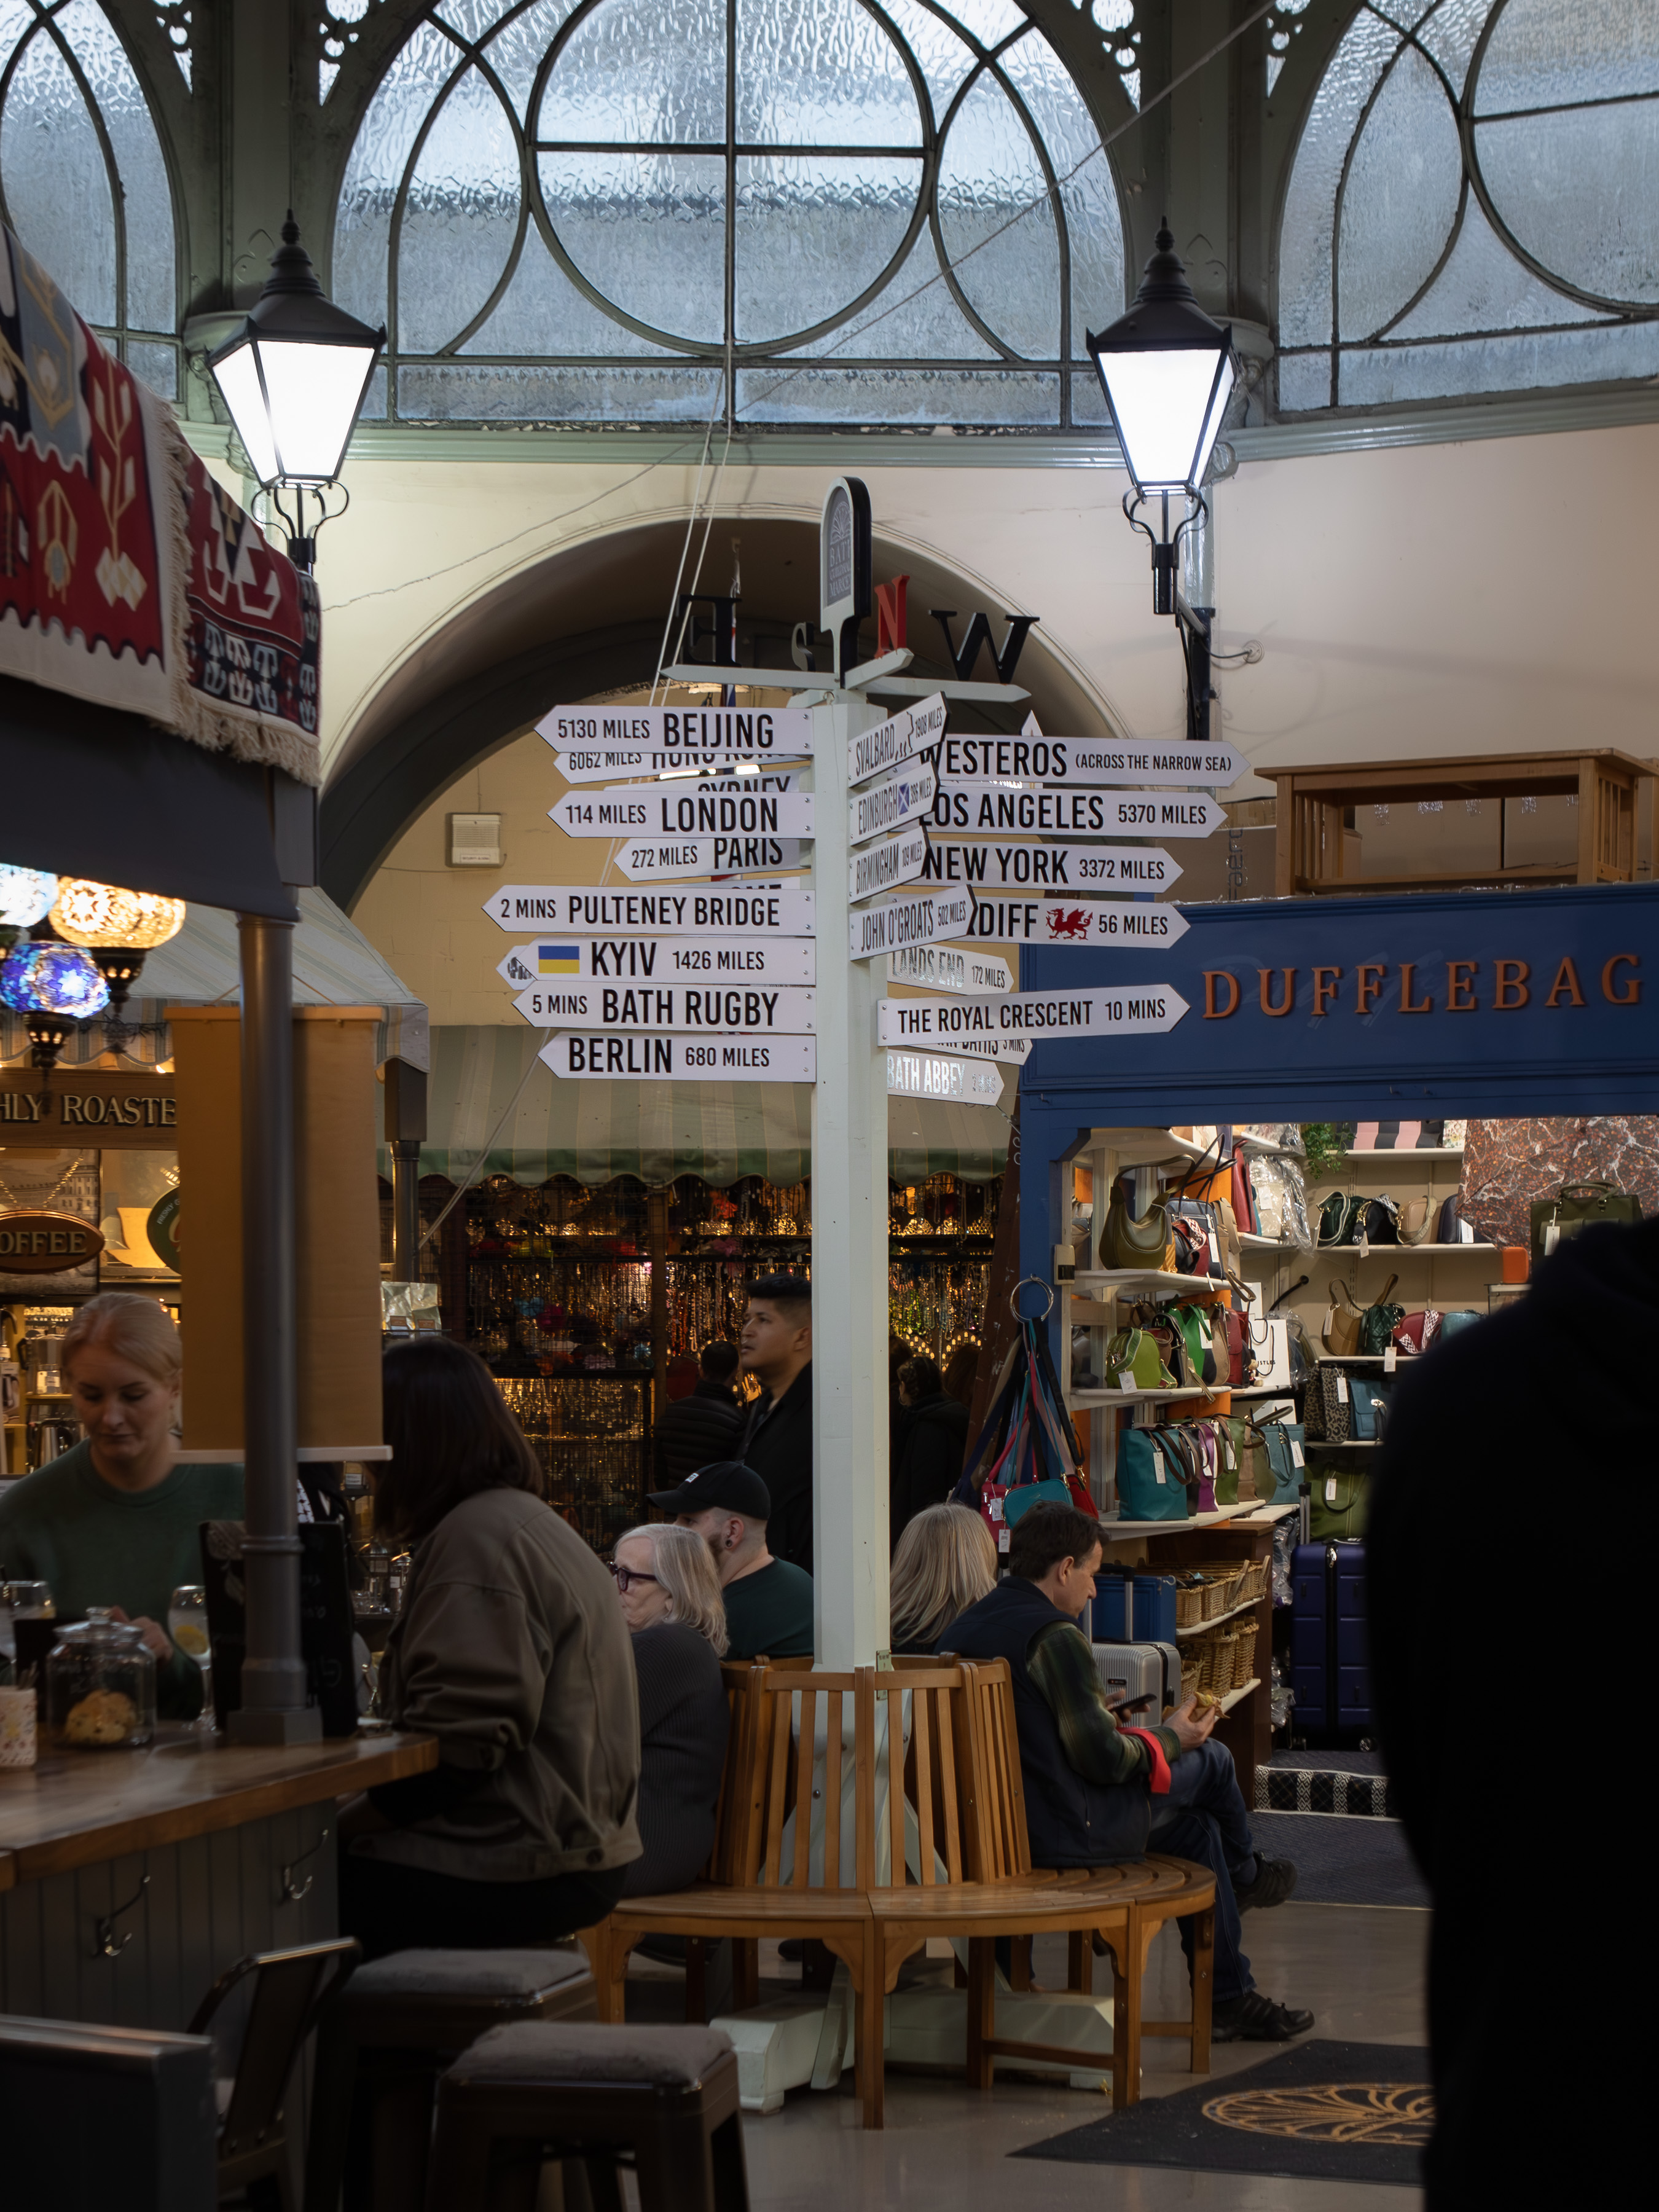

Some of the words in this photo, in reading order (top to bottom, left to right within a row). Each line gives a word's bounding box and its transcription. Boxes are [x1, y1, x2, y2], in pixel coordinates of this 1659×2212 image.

[874, 574, 910, 659] N
[928, 610, 1040, 684] W
[558, 719, 597, 739] 5130
[603, 720, 650, 739] MILES
[663, 713, 774, 748] BEIJING
[928, 706, 943, 733] MILES
[569, 753, 601, 771] 6062
[605, 752, 642, 767] MILES
[1075, 753, 1124, 769] (ACROSS
[1127, 755, 1149, 769] THE
[1153, 755, 1202, 771] NARROW
[1205, 756, 1231, 771] SEA)
[565, 805, 594, 824] 114
[599, 804, 646, 824] MILES
[661, 798, 778, 833] LONDON
[858, 783, 898, 836] EDINBURGH
[919, 776, 932, 802] MILES
[978, 793, 1104, 830] ANGELES
[1118, 804, 1156, 823] 5370
[1162, 805, 1207, 825] MILES
[632, 849, 654, 868] 272
[659, 845, 697, 866] MILES
[714, 838, 783, 869] PARIS
[856, 842, 899, 895] BIRMINGHAM
[910, 840, 923, 865] MILES
[925, 845, 988, 881] NEW
[996, 847, 1069, 885] YORK
[1079, 858, 1115, 878] 3372
[1121, 860, 1164, 880] MILES
[501, 898, 510, 918] 2
[516, 899, 556, 919] MINS
[569, 895, 687, 925] PULTENEY
[694, 897, 780, 927] BRIDGE
[861, 912, 885, 952] JOHN
[888, 899, 933, 945] O'GROATS
[938, 904, 949, 927] 502
[949, 900, 966, 924] MILES
[968, 903, 1039, 938] DIFF
[1099, 914, 1118, 934] 56
[1123, 915, 1168, 935] MILES
[591, 941, 657, 976] KYIV
[672, 951, 712, 970] 1426
[718, 951, 764, 970] MILES
[892, 946, 935, 983] LANDS
[939, 951, 965, 988] END
[971, 965, 983, 984] 172
[985, 967, 1005, 989] MILES
[1201, 954, 1643, 1019] DUFFLEBAG
[532, 994, 542, 1014] 5
[548, 995, 587, 1014] MINS
[603, 989, 673, 1024] BATH
[686, 990, 779, 1026] RUGBY
[897, 1008, 931, 1033] THE
[938, 1005, 994, 1032] ROYAL
[1000, 1000, 1093, 1029] CRESCENT
[1105, 1001, 1123, 1021] 10
[1128, 998, 1166, 1020] MINS
[568, 1037, 672, 1073] BERLIN
[686, 1046, 716, 1066] 680
[723, 1048, 769, 1067] MILES
[887, 1055, 920, 1092] BATH
[923, 1059, 966, 1096] ABBEY
[0, 1231, 87, 1254] OFFEE
